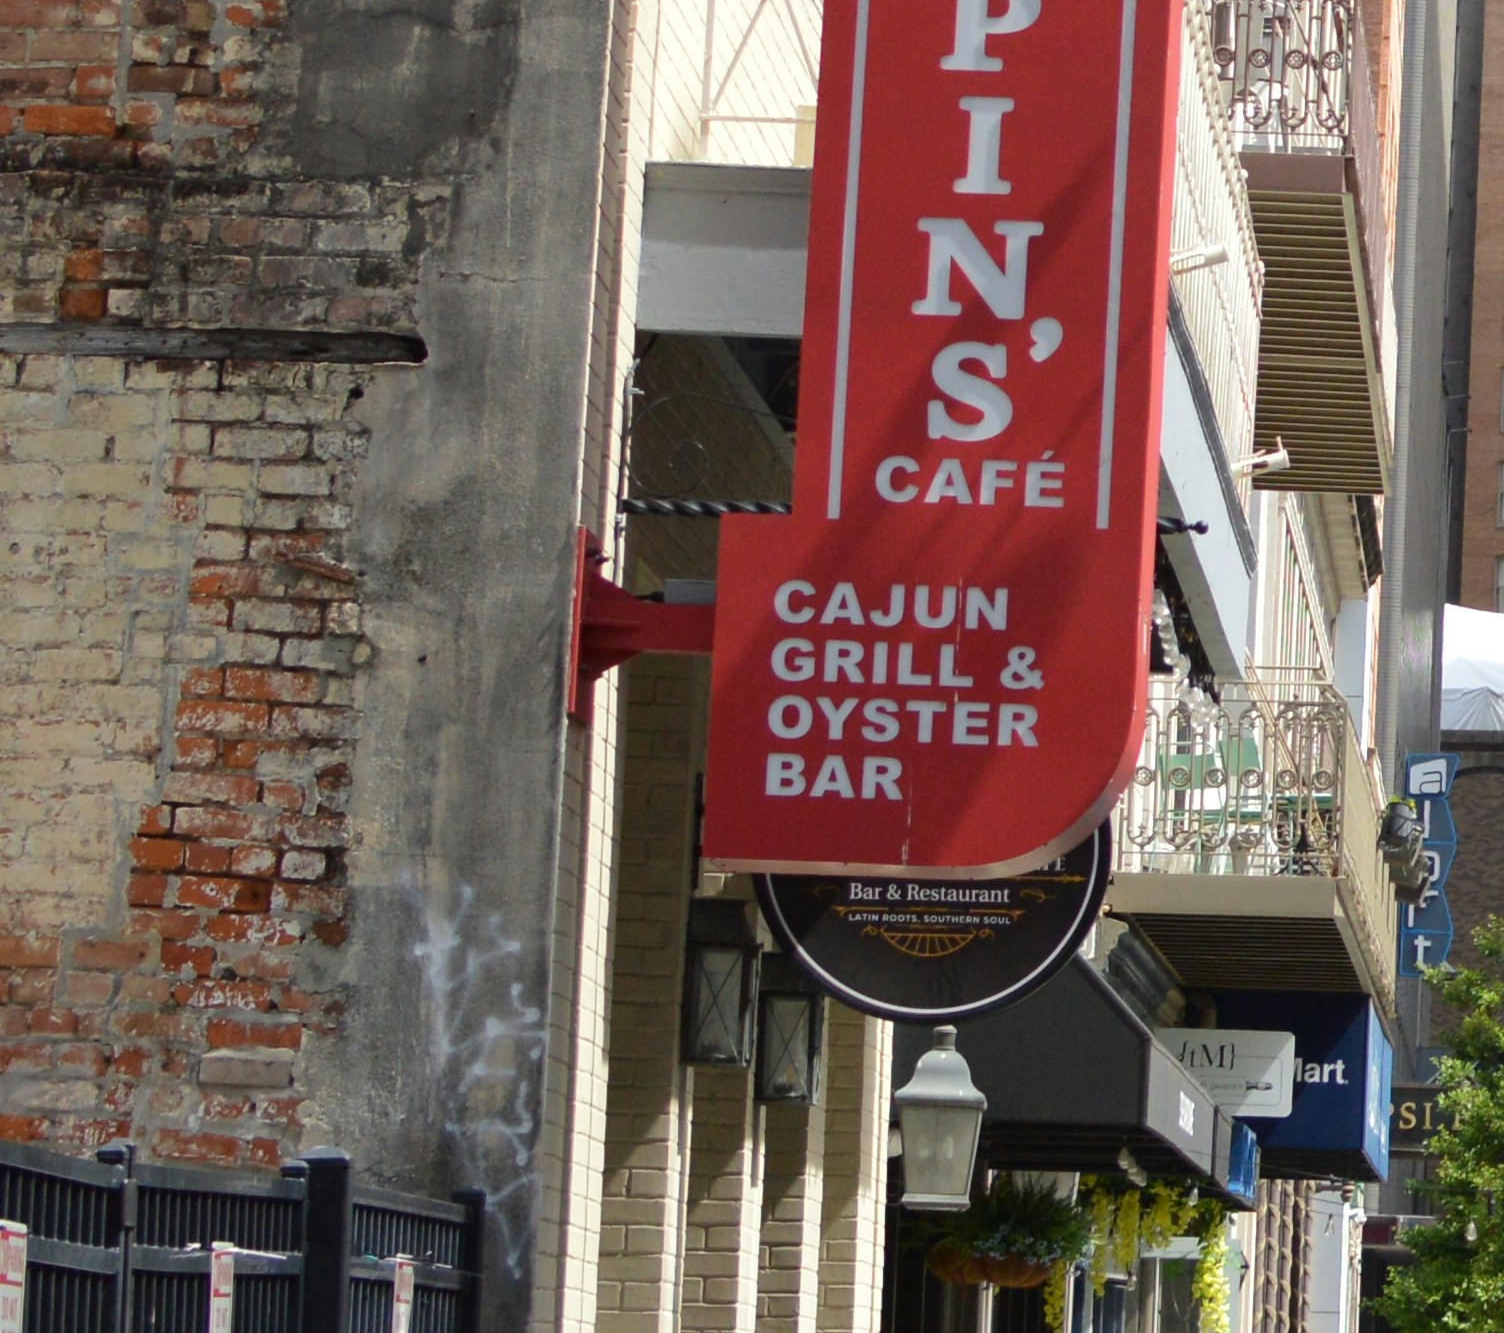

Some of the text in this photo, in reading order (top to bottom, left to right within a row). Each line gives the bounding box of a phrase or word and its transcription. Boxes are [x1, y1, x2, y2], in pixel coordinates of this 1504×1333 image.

[875, 450, 1065, 508] CAFÉ
[774, 580, 1008, 630] CAJUN
[771, 638, 1045, 690] GRILL &
[767, 695, 1039, 747] OYSTER
[765, 753, 903, 800] BAR
[849, 882, 1010, 903] Bar & Restaurant
[848, 913, 879, 922] LATIN
[923, 915, 980, 923] SOUTHERN
[983, 916, 1011, 925] SOUL
